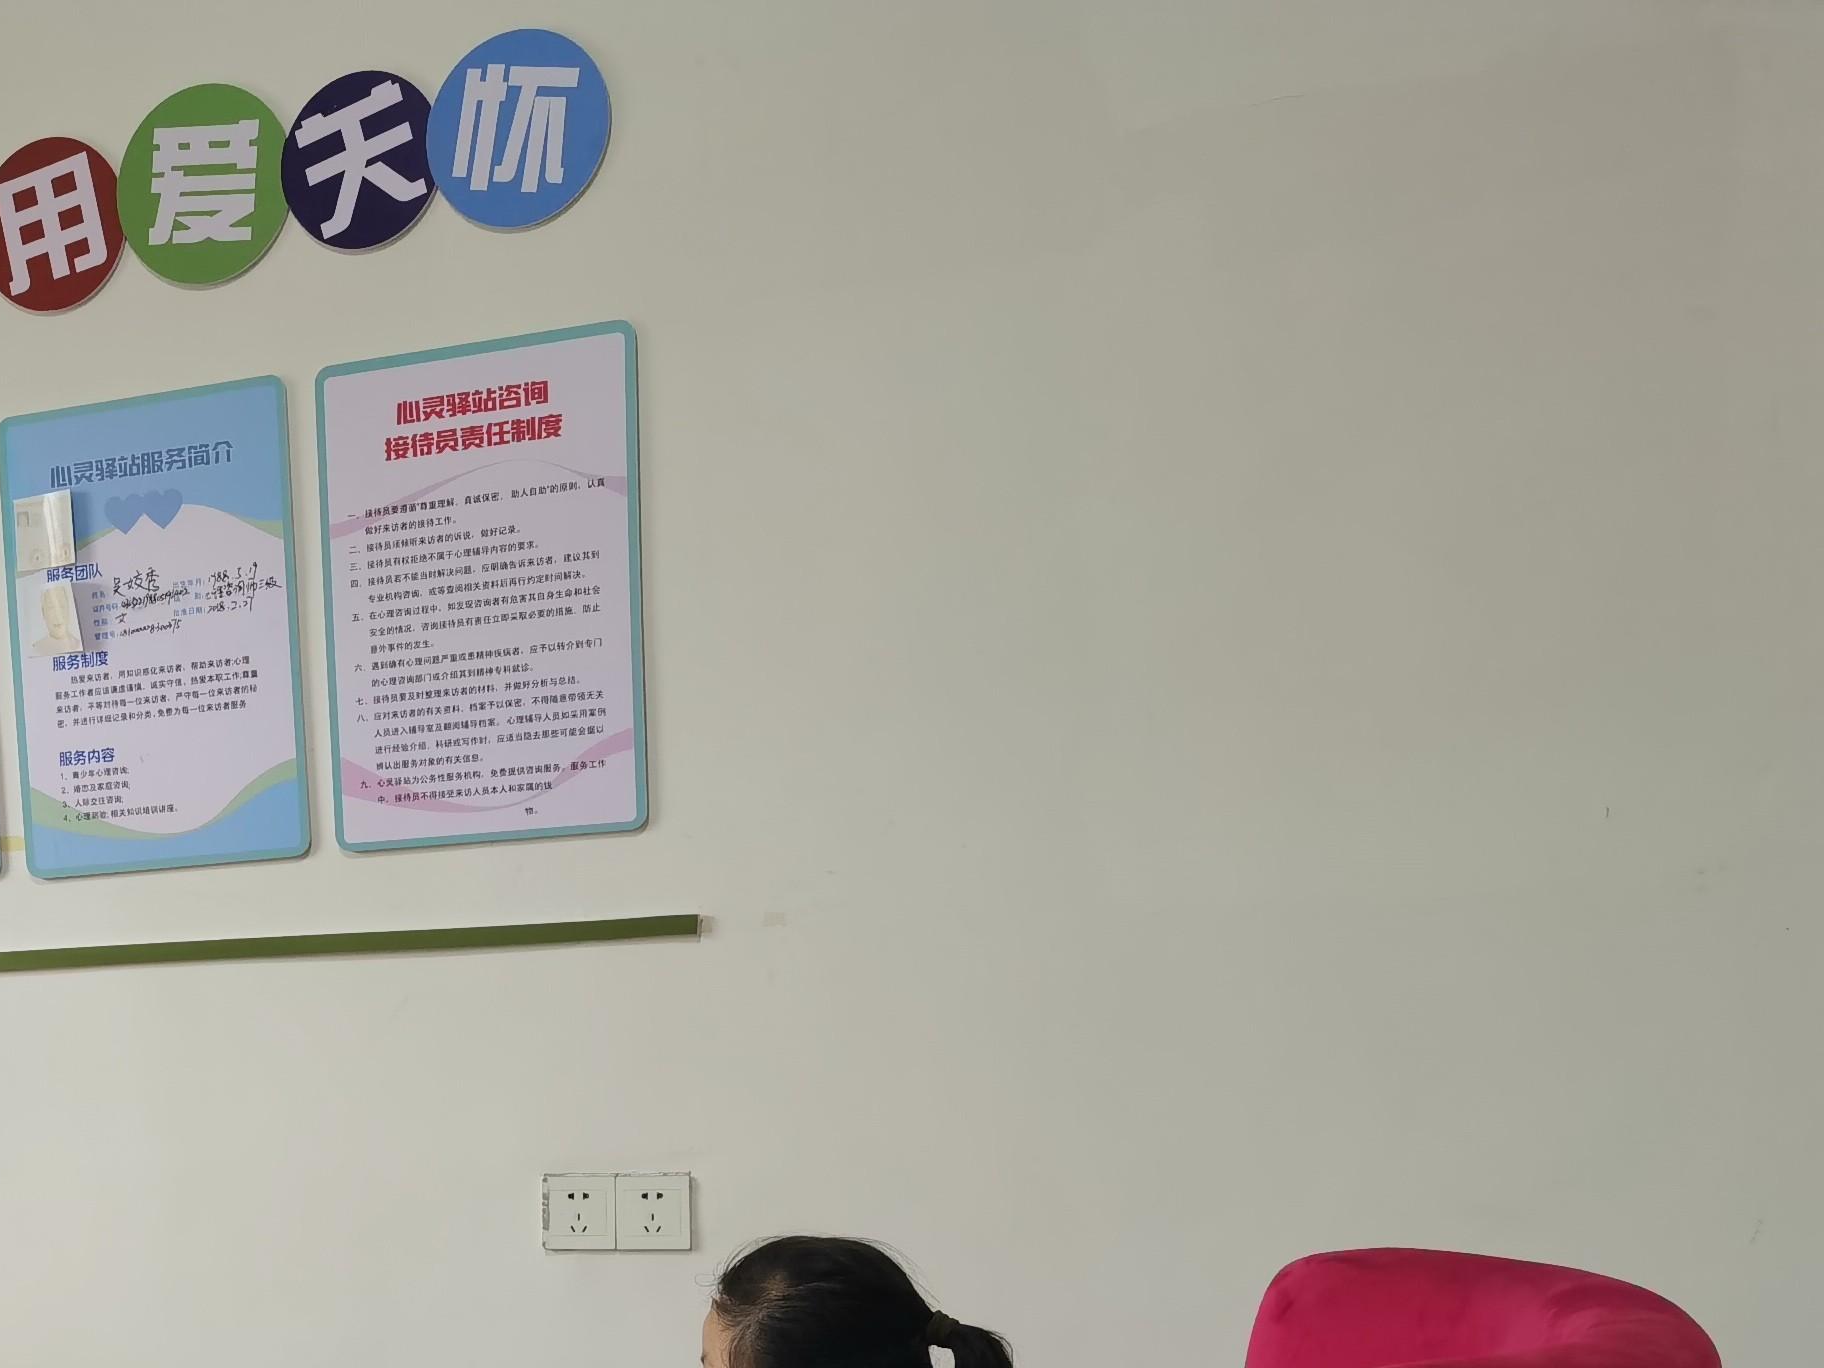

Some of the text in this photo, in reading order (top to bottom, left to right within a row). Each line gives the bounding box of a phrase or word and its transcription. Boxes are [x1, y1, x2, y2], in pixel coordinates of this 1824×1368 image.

[395, 379, 549, 425] 心灵驿站咨询
[384, 413, 563, 461] 接待员责任制度
[49, 440, 233, 488] 心灵驿站服务简介
[46, 562, 102, 584] 服务团队
[52, 650, 109, 671] 服务制度
[58, 746, 115, 767] 服务内容
